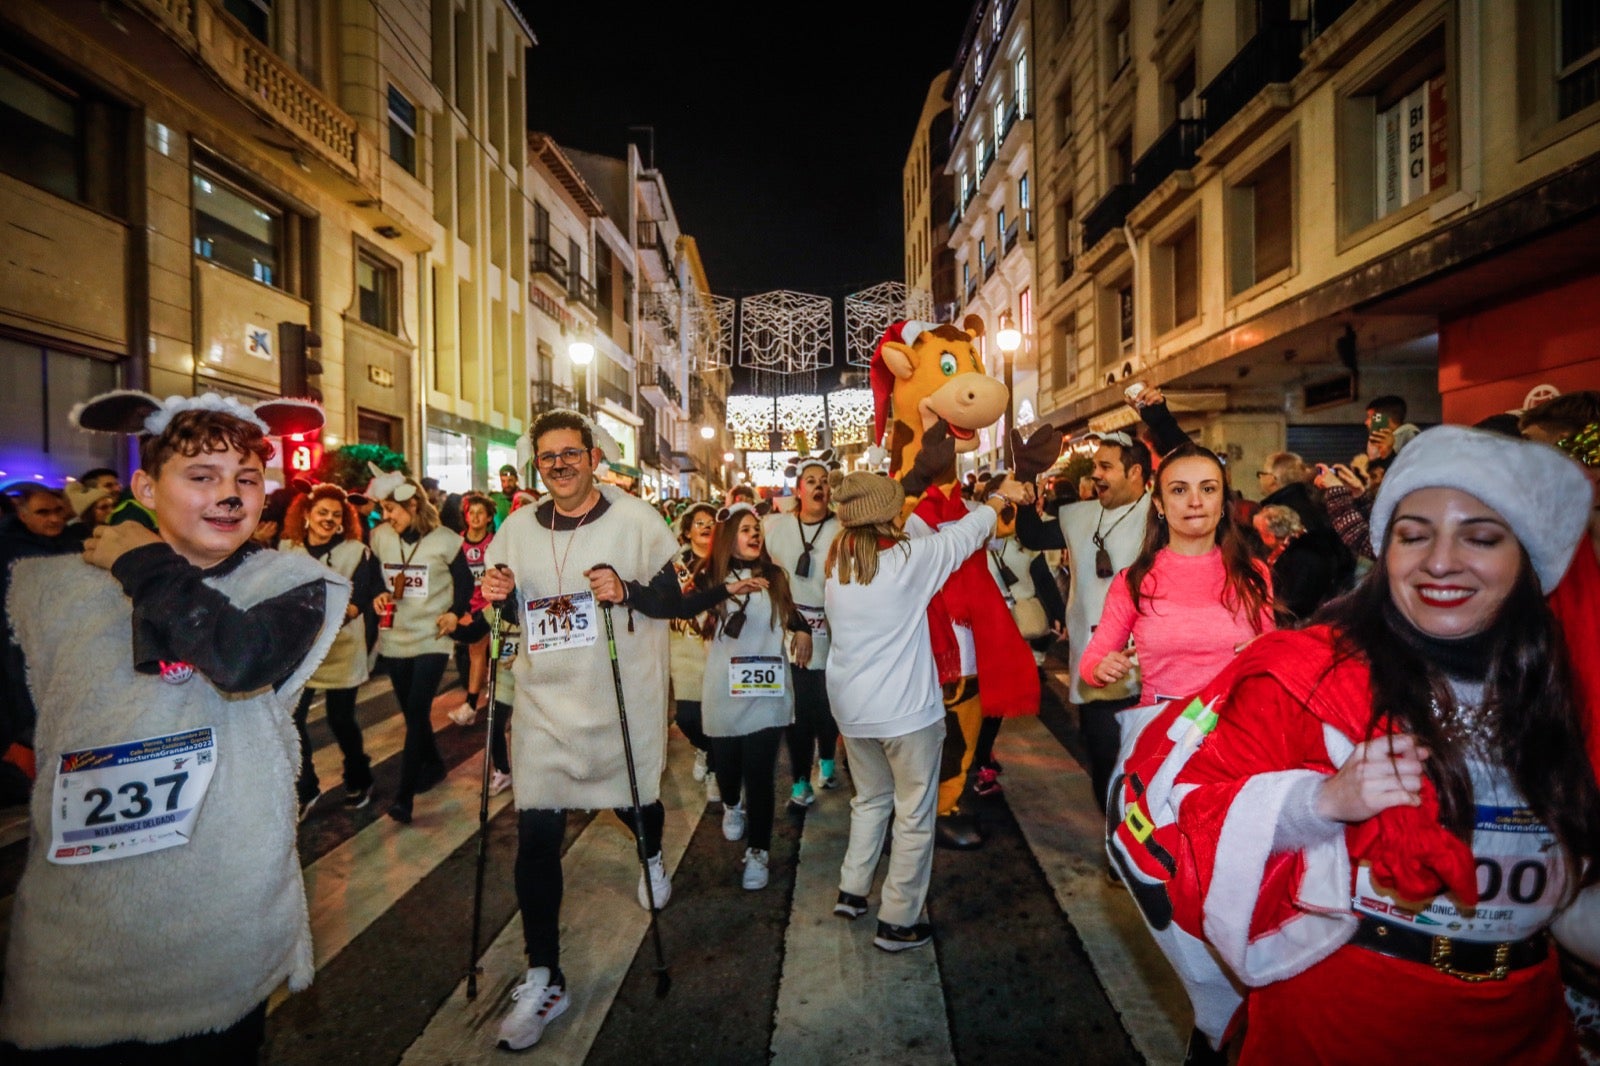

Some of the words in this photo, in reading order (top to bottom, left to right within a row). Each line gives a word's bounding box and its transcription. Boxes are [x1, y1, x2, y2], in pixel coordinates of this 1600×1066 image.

[1410, 105, 1424, 128] B1
[1410, 131, 1424, 154] B2
[1410, 158, 1424, 178] C1
[389, 576, 423, 588] 129
[741, 669, 776, 684] 250
[118, 740, 213, 764] #NocturnaGranada2022
[83, 771, 189, 827] 237
[110, 822, 141, 835] SANCHEZ
[143, 814, 176, 828] DELGADO
[1489, 909, 1514, 920] LOPEZ
